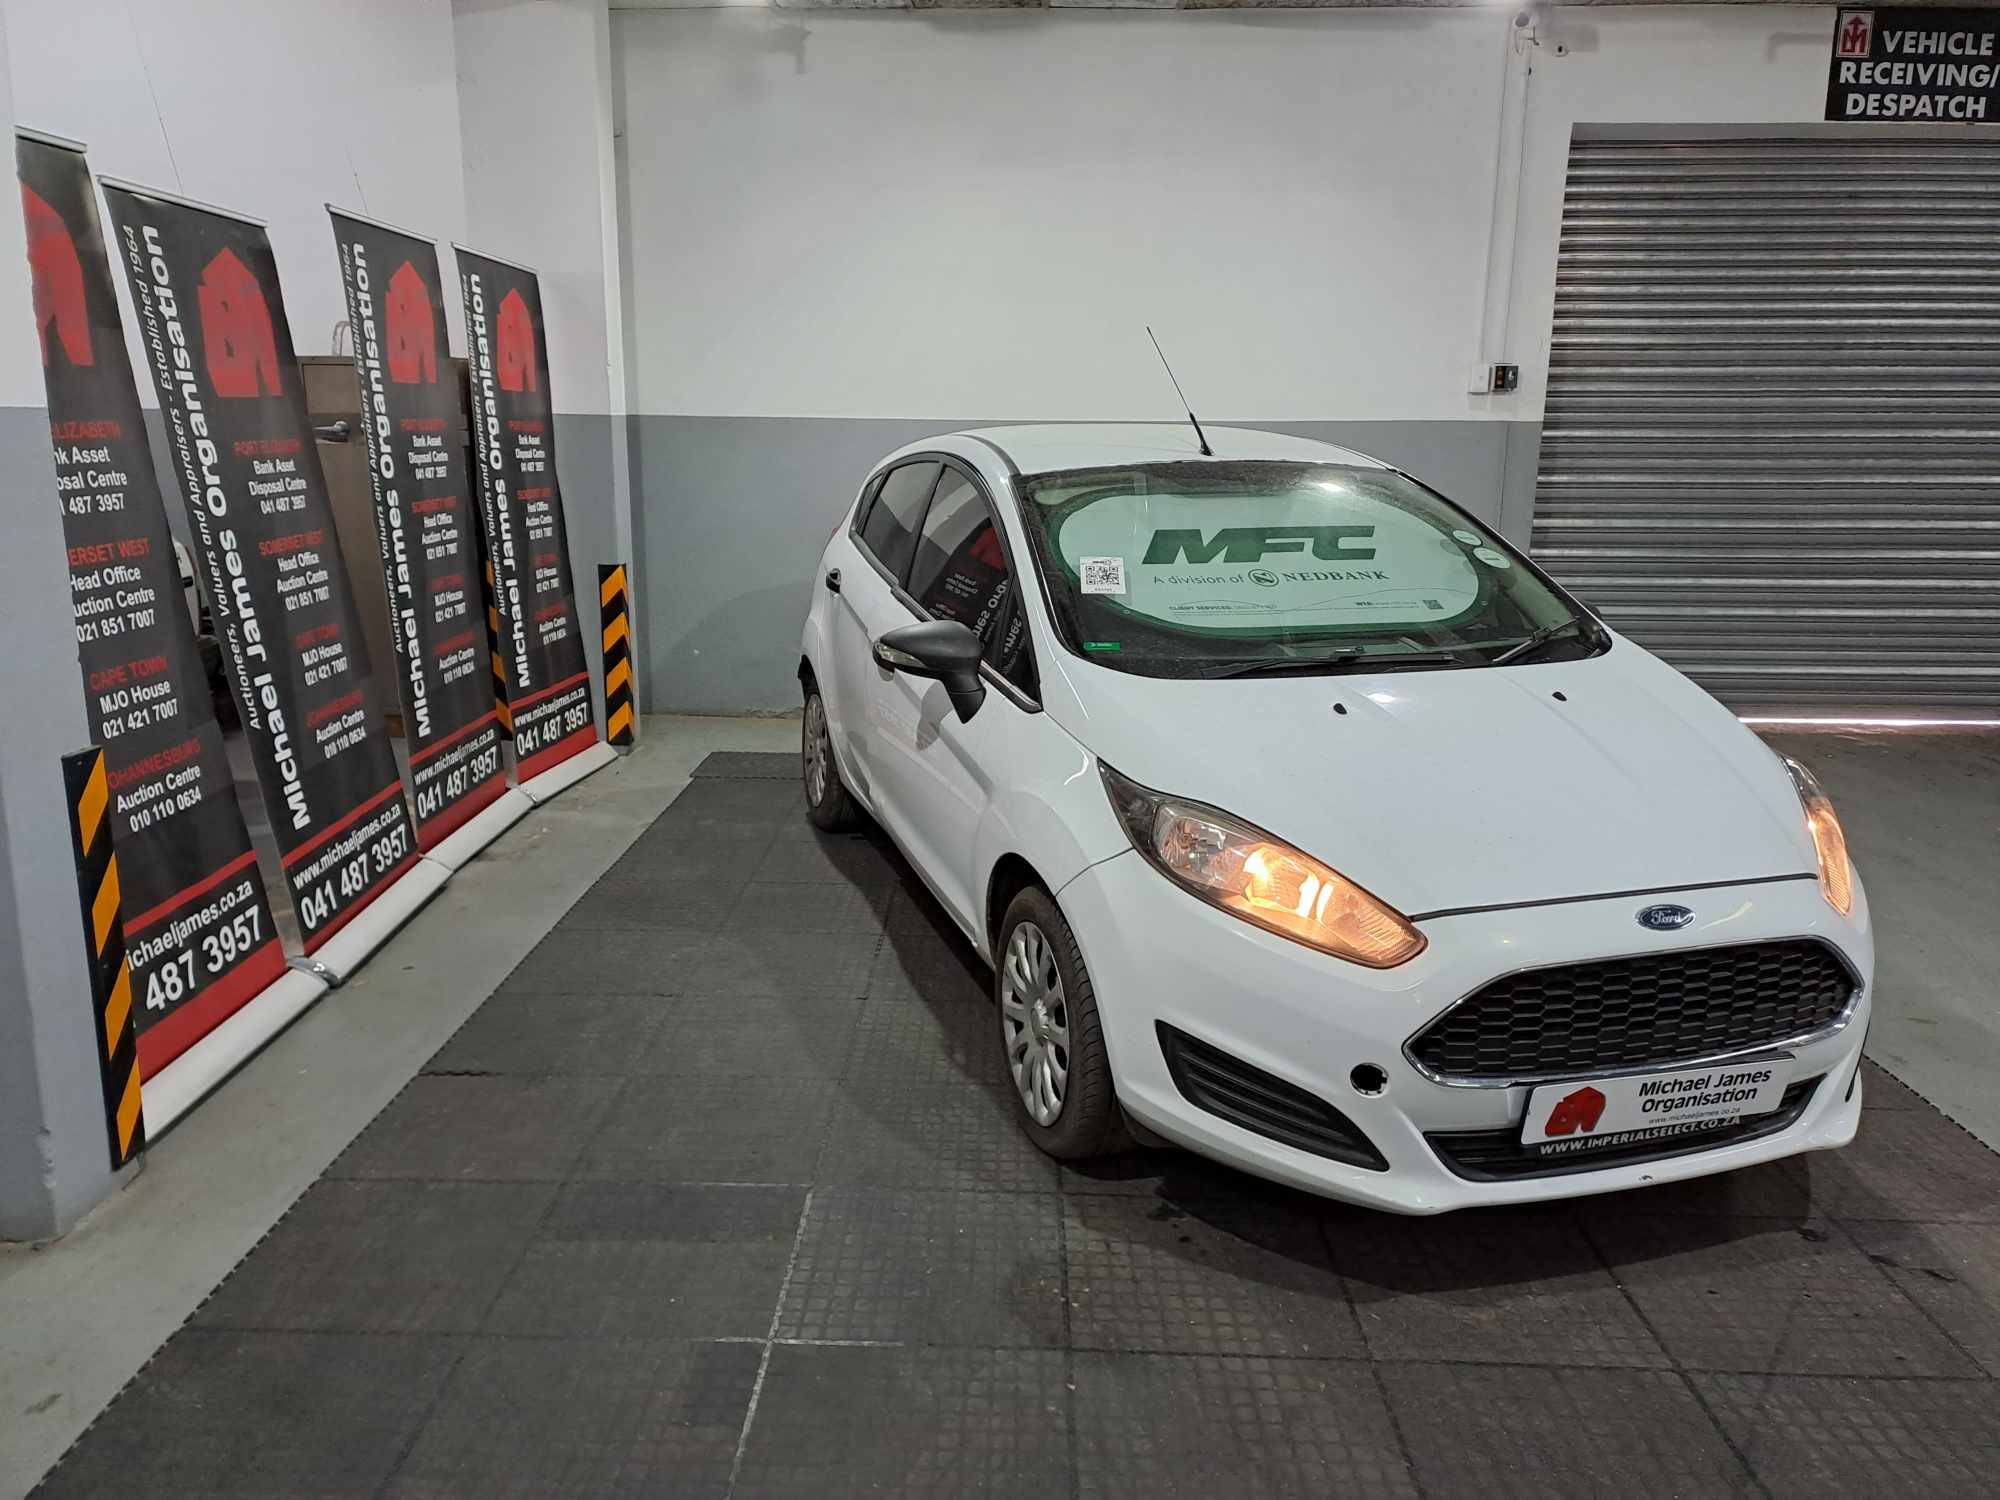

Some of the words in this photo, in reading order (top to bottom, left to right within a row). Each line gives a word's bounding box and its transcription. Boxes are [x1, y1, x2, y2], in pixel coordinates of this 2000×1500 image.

[1882, 30, 1995, 56] VEHICLE
[1839, 61, 2000, 88] RECEIVING/
[1845, 93, 1987, 118] DESPATCH
[123, 225, 144, 274] 1964
[135, 279, 173, 389] Established
[142, 225, 227, 517] Organisation
[353, 243, 395, 479] Organisation
[470, 274, 502, 470] Organisation
[72, 446, 111, 463] Asset
[87, 470, 127, 487] Centre
[169, 408, 203, 504] Appraisers
[69, 496, 91, 514] 487
[96, 493, 124, 511] 3957
[248, 478, 285, 497] Disposal
[195, 510, 212, 546] and
[387, 490, 412, 599] James
[495, 479, 515, 571] James
[1142, 526, 1376, 564] MFC
[68, 543, 114, 566] ERSET
[118, 538, 149, 557] WEST
[102, 566, 141, 585] Office
[207, 551, 230, 617] Valuers
[219, 529, 267, 663] James
[276, 573, 306, 593] Auction
[1154, 576, 1164, 585] A
[1169, 575, 1226, 584] division
[1231, 574, 1244, 584] of
[1283, 570, 1391, 582] NEDBANK
[73, 596, 114, 617] uction
[116, 588, 155, 607] Centre
[76, 622, 99, 642] 021
[101, 616, 125, 636] 851
[127, 609, 155, 629] 7007
[317, 643, 343, 659] House
[505, 578, 530, 688] Michael
[226, 623, 261, 730] Auctioneers,
[401, 608, 431, 738] Michael
[100, 690, 128, 714] MJO
[130, 681, 171, 704] House
[103, 717, 124, 739] 021
[128, 709, 150, 729] 421
[152, 699, 178, 722] 7007
[254, 672, 311, 831] Michael
[516, 726, 540, 757] 041
[542, 715, 561, 744] 487
[565, 702, 588, 733] 3957
[414, 728, 495, 786] www.michaeljames.co.za
[117, 782, 163, 813] Auction
[166, 765, 201, 790] Centre
[417, 781, 443, 819] 041
[446, 766, 467, 799] 487
[470, 745, 497, 783] 3957
[129, 812, 150, 832] 010
[152, 798, 174, 821] 110
[176, 786, 201, 811] 0634
[293, 803, 400, 890] www.michaeljames.co.za
[300, 880, 337, 929] 041
[341, 852, 369, 897] 487
[372, 823, 407, 872] 3957
[126, 880, 253, 971] ichaeljames.co.za
[146, 949, 195, 1011] 487
[202, 904, 261, 973] 3957
[1639, 1075, 1712, 1096] Michael
[1714, 1070, 1772, 1087] James
[1642, 1088, 1757, 1112] Organisation
